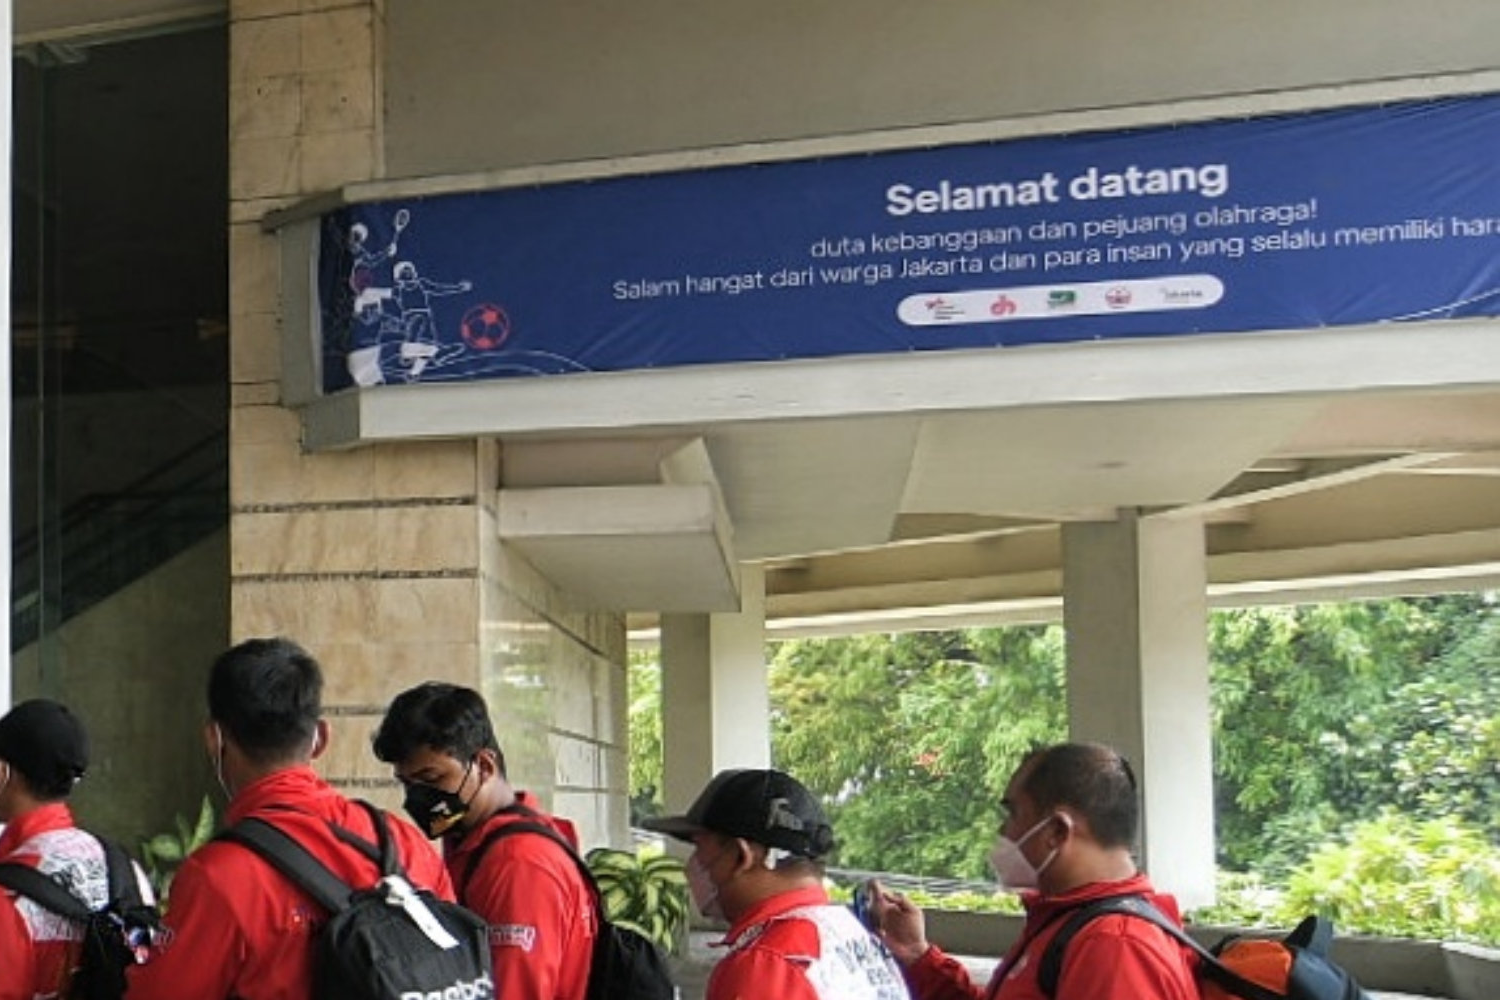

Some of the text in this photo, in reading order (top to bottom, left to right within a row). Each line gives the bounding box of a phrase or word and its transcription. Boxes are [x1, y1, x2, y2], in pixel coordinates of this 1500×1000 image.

[885, 164, 1229, 216] Selamat datang
[811, 199, 1317, 257] duta kebanggaan dan pejuang olahraga!
[612, 278, 680, 300] Salam
[685, 271, 764, 294] hangat
[769, 266, 814, 287] dari
[819, 262, 893, 285] warga
[899, 252, 983, 278] Jakarta
[989, 251, 1036, 272] dan
[1044, 245, 1100, 271] para
[1106, 241, 1171, 263] insan
[1179, 228, 1244, 262] yang
[1250, 223, 1326, 253] selalu
[1334, 216, 1444, 246] memiliki
